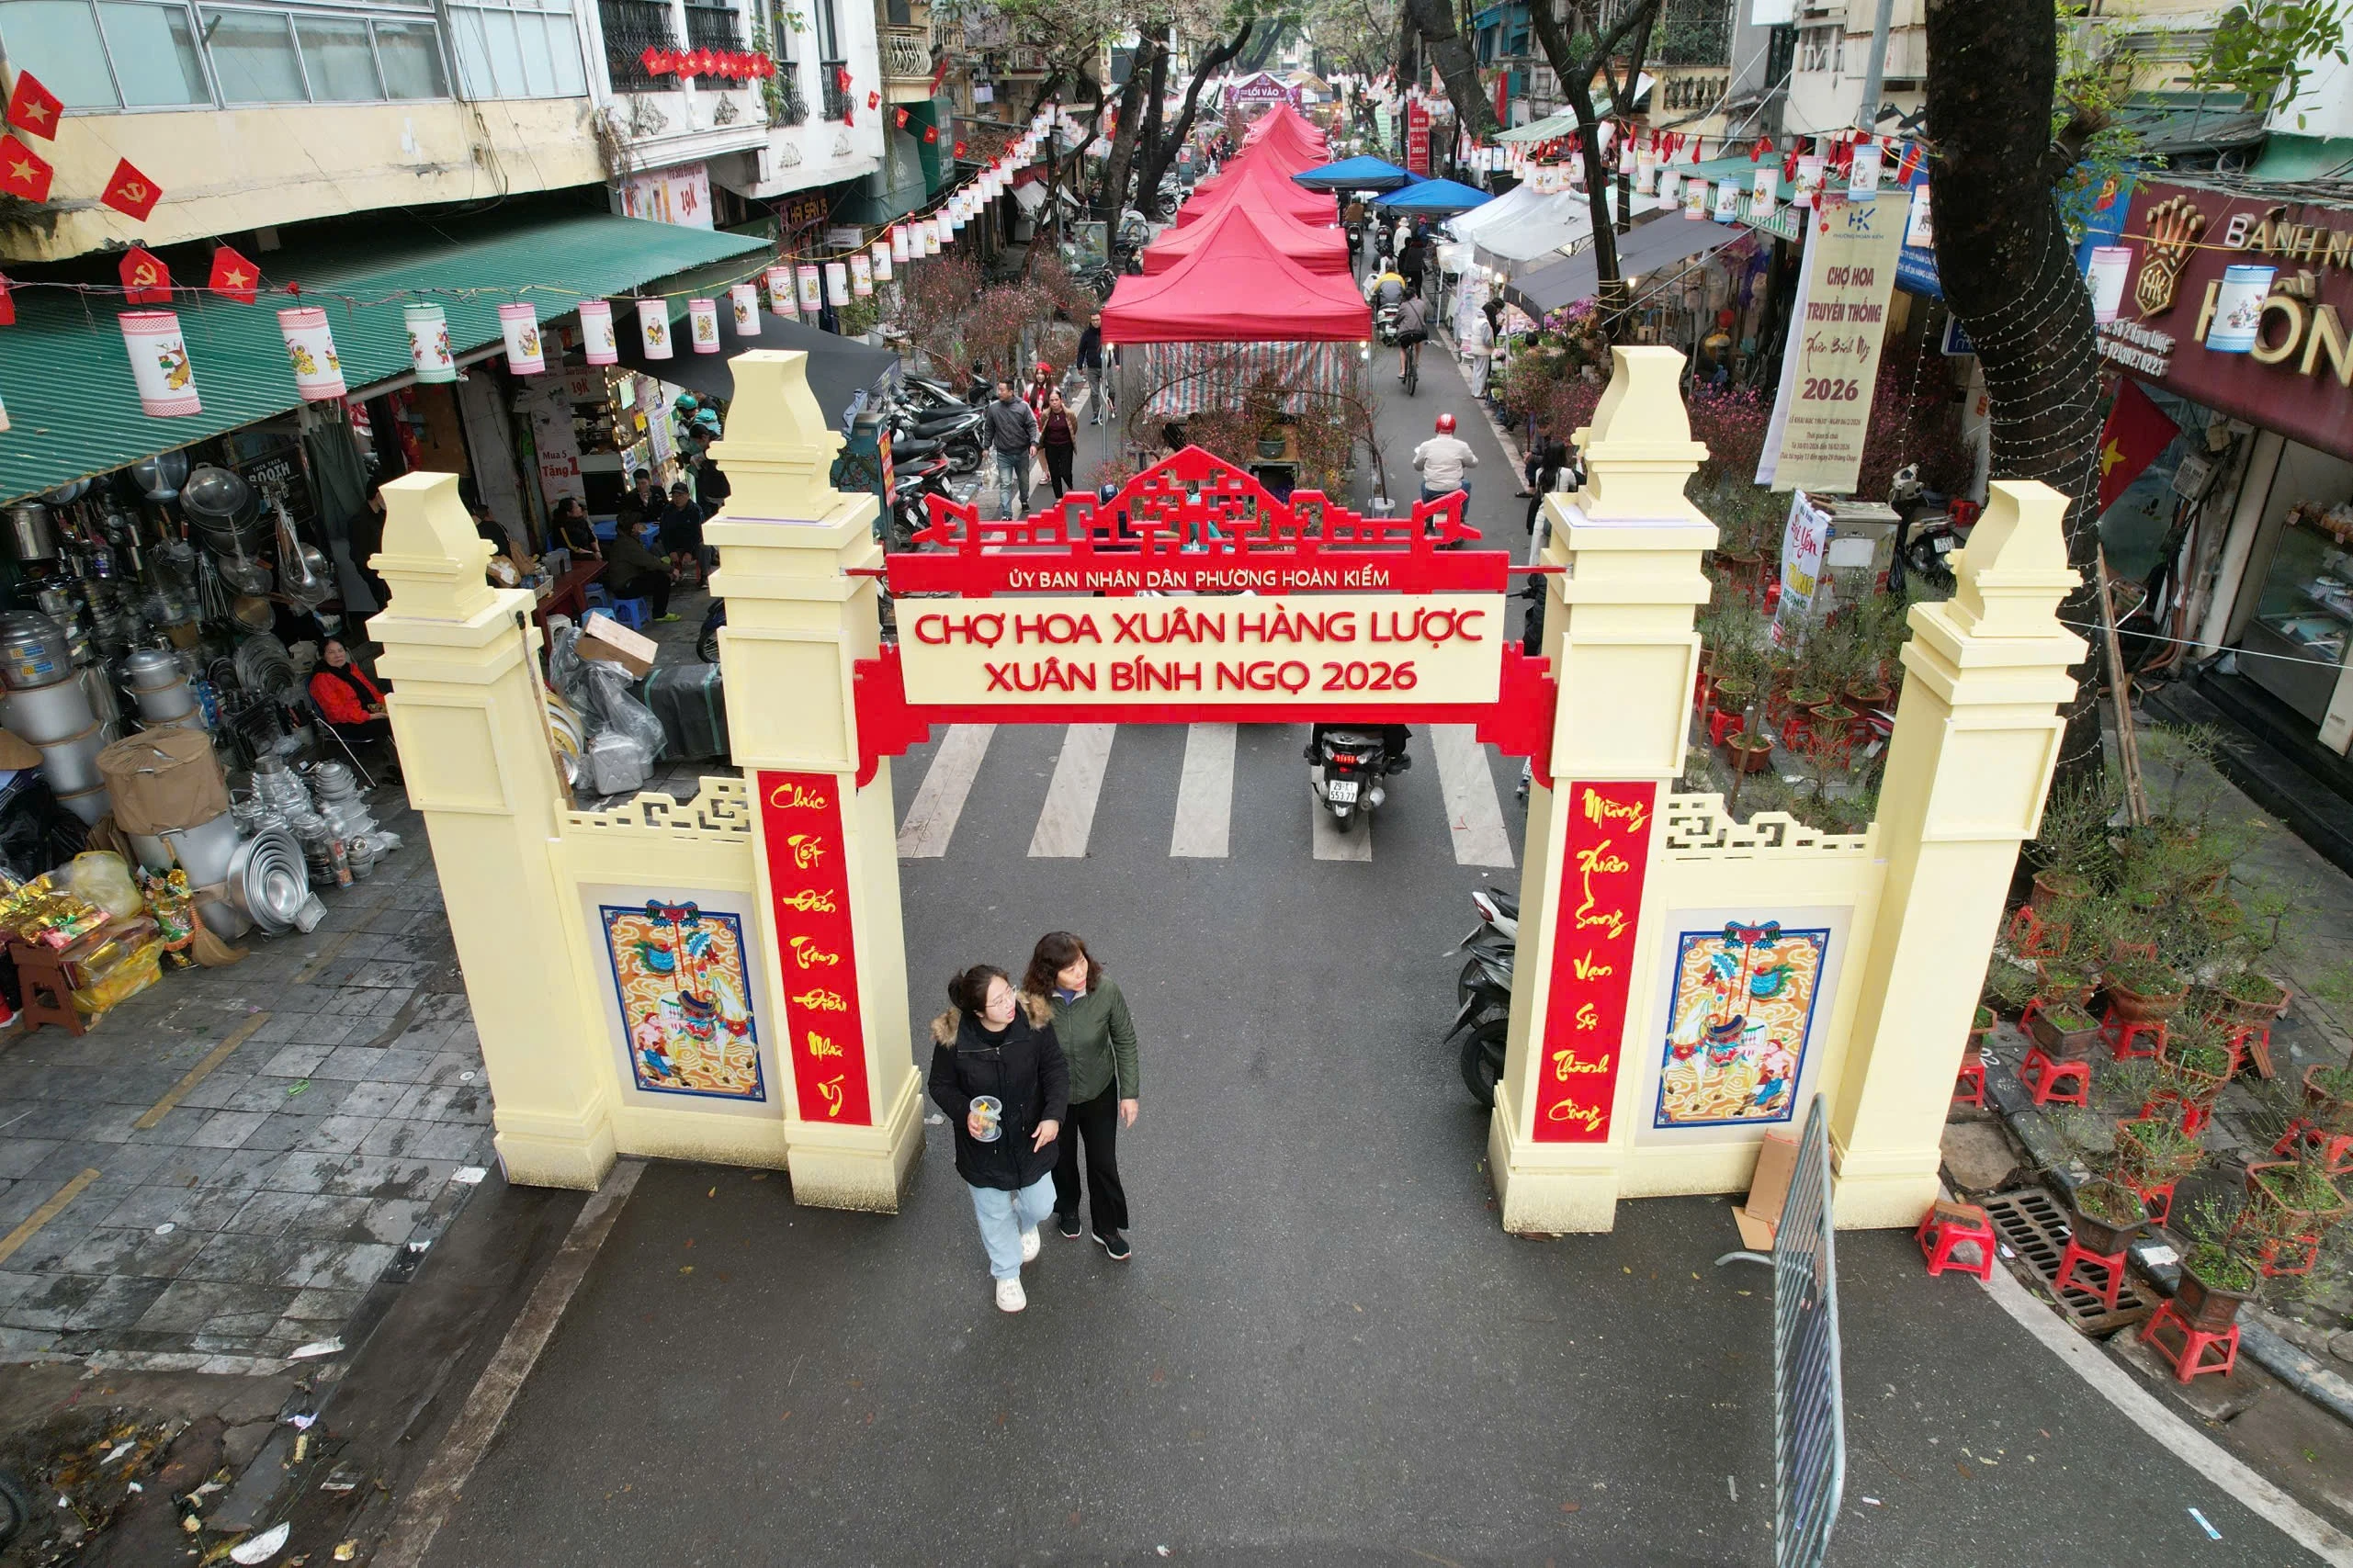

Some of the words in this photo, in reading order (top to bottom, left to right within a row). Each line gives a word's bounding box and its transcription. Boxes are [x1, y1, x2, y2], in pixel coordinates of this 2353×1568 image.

[1248, 86, 1261, 96] LỐI
[1261, 86, 1279, 96] VÀO
[681, 183, 696, 216] 19K
[2224, 205, 2319, 263] BÁNH
[1827, 265, 1850, 290] CHỢ
[1851, 267, 1874, 287] HOA
[1807, 296, 1845, 321] TRUYỀN
[1848, 296, 1883, 323] THỐNG
[571, 378, 589, 395] 19K
[1802, 378, 1859, 401] 2026
[542, 451, 560, 460] Mua
[542, 465, 568, 479] Tặng
[568, 457, 581, 475] 1
[1009, 566, 1038, 588] ỦY
[1041, 570, 1079, 588] BAN
[1087, 567, 1139, 588] NHÂN
[1148, 567, 1187, 588] DÂN
[1196, 567, 1276, 588] PHƯỜNG
[1283, 566, 1337, 587] HOÀN
[1344, 563, 1389, 587] KIẾM
[915, 613, 1006, 649] CHỢ
[1015, 614, 1103, 644] HOA
[1112, 606, 1225, 643] XUÂN
[1239, 603, 1356, 643] HÀNG
[1371, 606, 1485, 649] LƯỢC
[984, 656, 1097, 692] XUÂN
[1112, 654, 1202, 692] BÍNH
[1216, 660, 1310, 695] NGỌ
[1321, 660, 1418, 692] 2026
[770, 783, 829, 809] Chúc
[1581, 787, 1653, 833] Mừng
[787, 834, 827, 870] Tết
[1576, 840, 1629, 902] Xuân
[783, 888, 836, 913] Đến
[1575, 900, 1632, 940] Sang
[1573, 949, 1612, 981] Vạn
[792, 988, 847, 1012] Điều
[1576, 1002, 1599, 1031] Sự
[1553, 1049, 1610, 1082] Thành
[818, 1074, 844, 1117] Ý
[1548, 1099, 1609, 1132] Công
